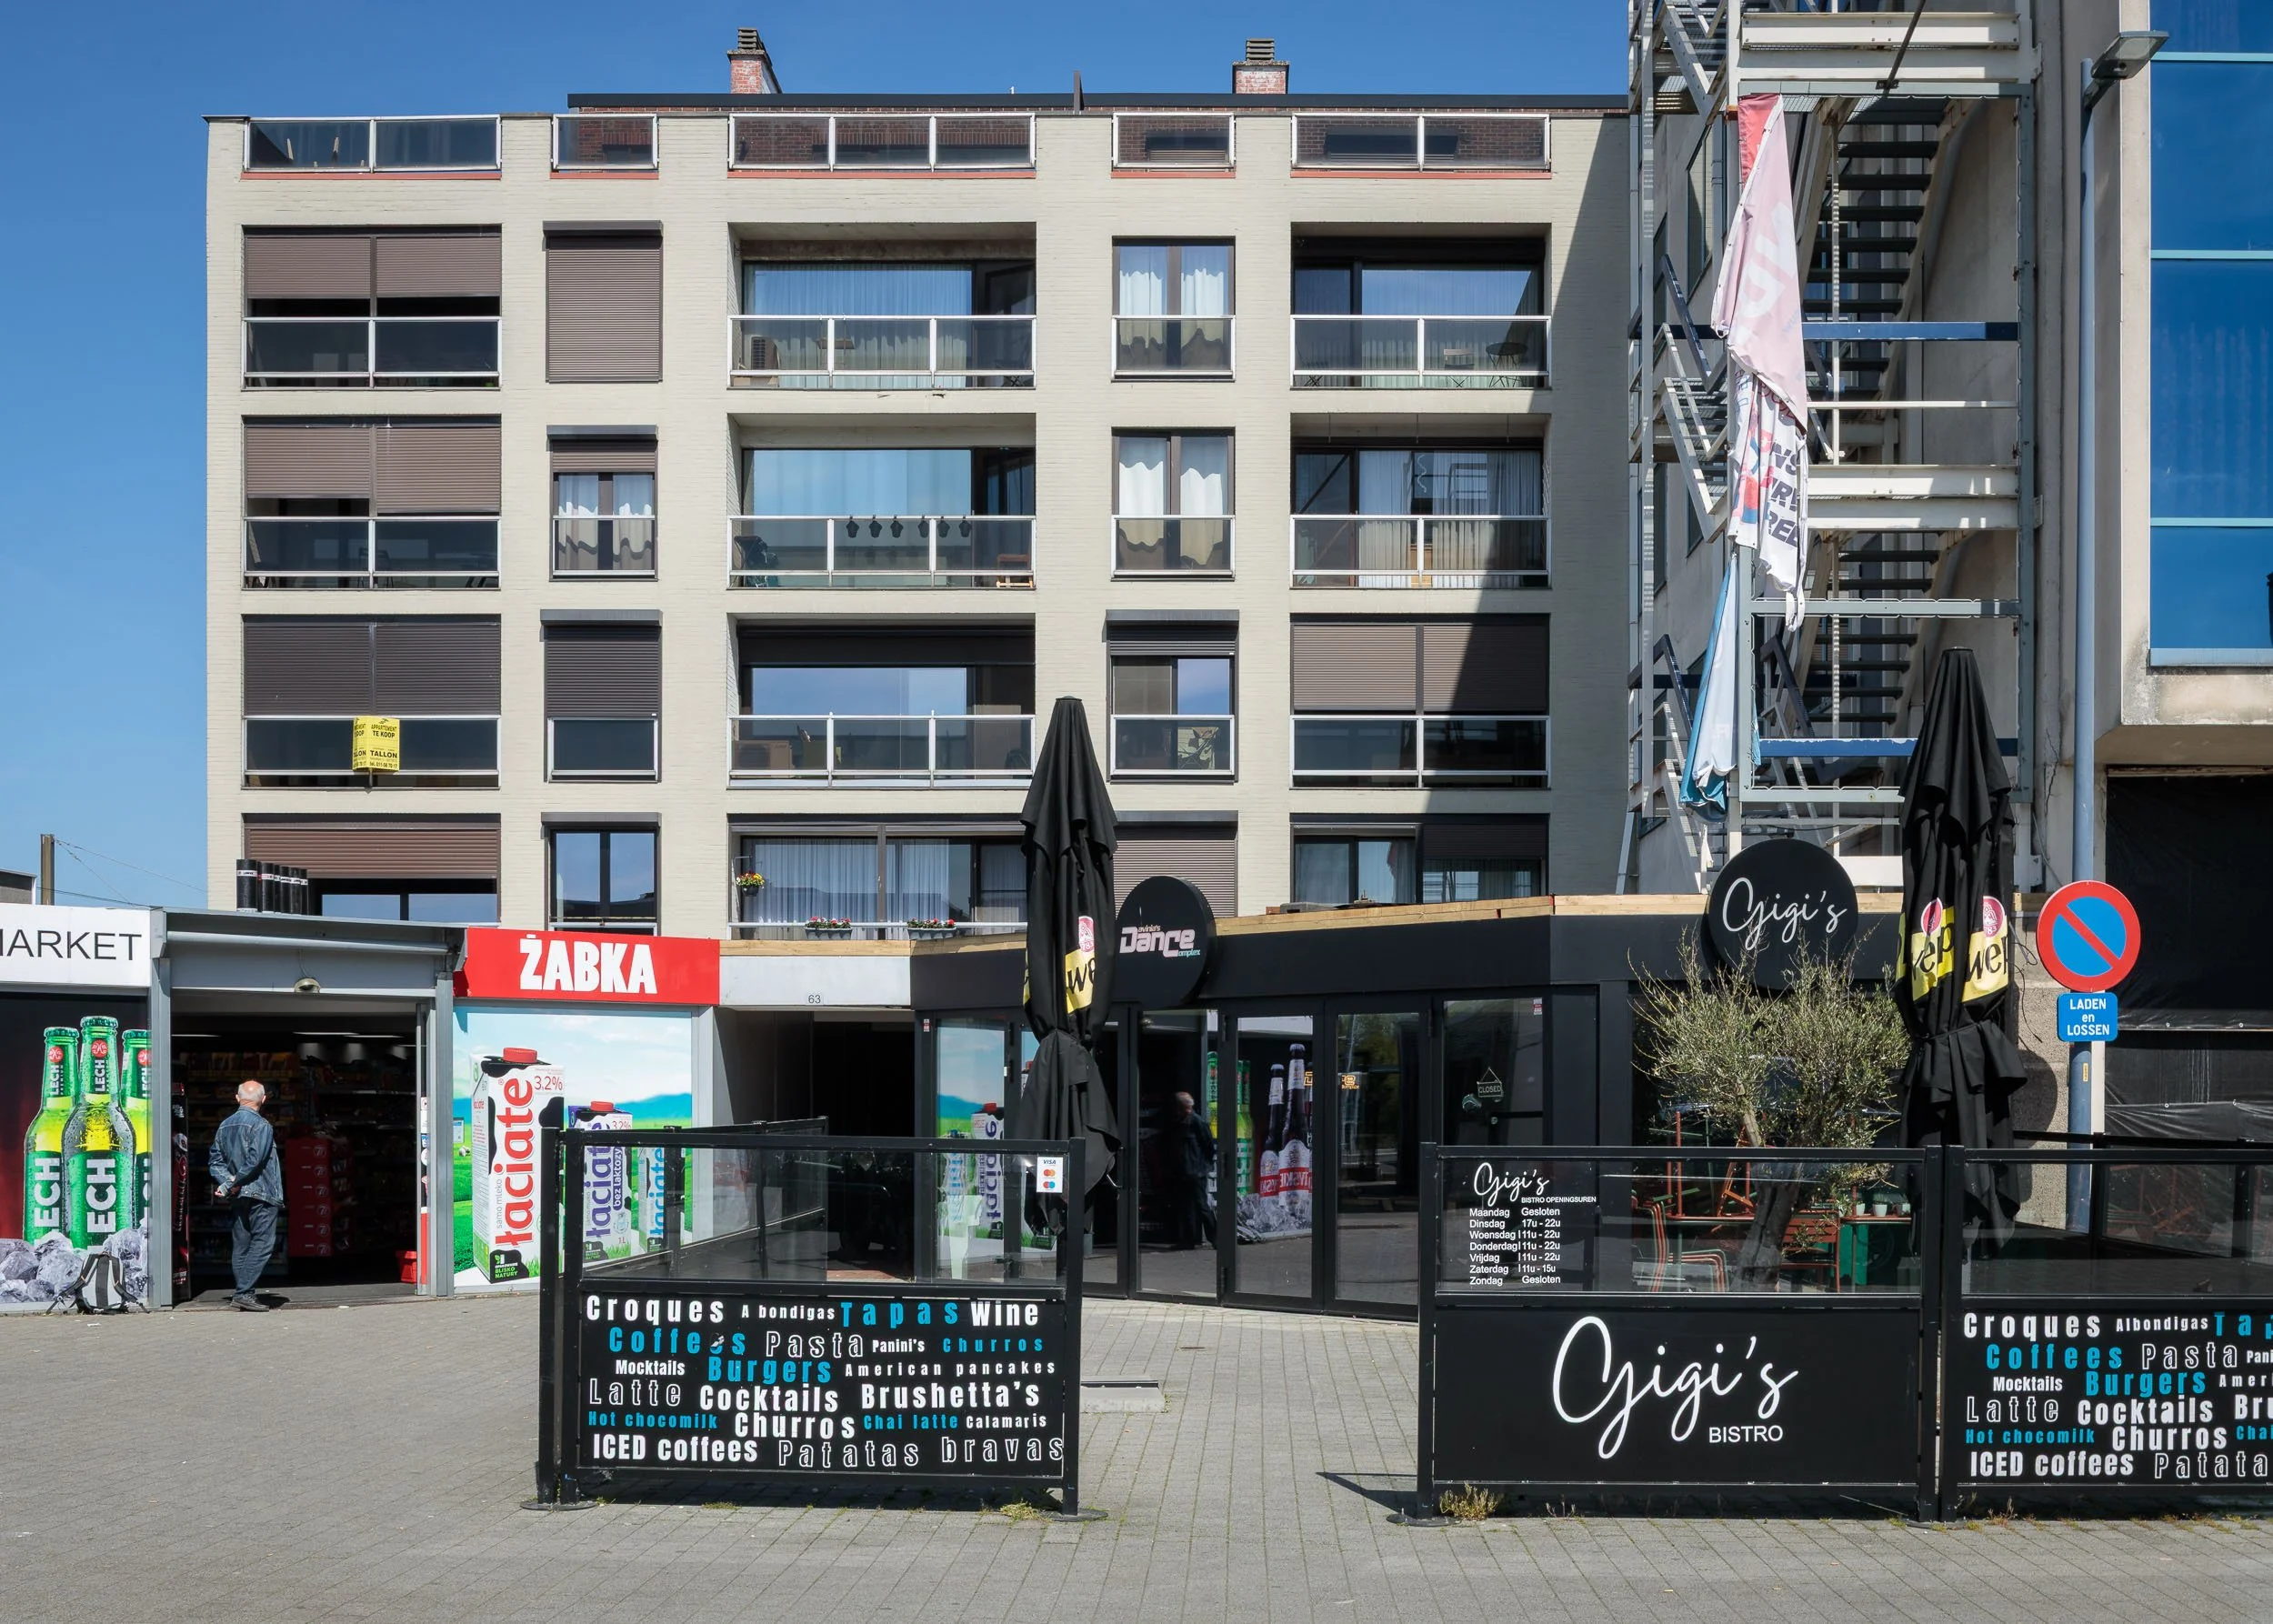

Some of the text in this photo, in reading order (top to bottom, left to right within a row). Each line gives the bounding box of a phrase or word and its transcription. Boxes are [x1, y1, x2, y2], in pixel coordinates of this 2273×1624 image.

[370, 750, 397, 758] TALLON
[1722, 877, 1847, 951] Gigi's
[0, 928, 142, 961] ARKET
[519, 934, 657, 994] ŻABKA
[808, 994, 821, 1004] 63
[2069, 998, 2107, 1010] LADEN
[2067, 1024, 2109, 1036] LOSSEN
[2082, 1014, 2095, 1022] en
[95, 1059, 105, 1091] LECH
[614, 1148, 623, 1208] bez laktozy
[1474, 1162, 1549, 1207] Gigi's
[1469, 1208, 1560, 1218] Maandag Gesloten
[1469, 1219, 1505, 1229] Dinsdag
[1522, 1218, 1537, 1228] 17u
[1545, 1218, 1561, 1228] 22u
[1469, 1230, 1516, 1240] Woensdag
[1522, 1230, 1537, 1238] 11u
[1545, 1230, 1560, 1238] 22u
[1469, 1242, 1517, 1251] Donderdag
[1522, 1241, 1537, 1250] 11u
[1545, 1241, 1560, 1249] 22u
[1469, 1253, 1500, 1263] Vrijdag
[1522, 1253, 1537, 1261] 11u
[1545, 1252, 1560, 1261] 22u
[1469, 1265, 1509, 1274] Zaterdag
[1522, 1264, 1536, 1273] 11u
[1542, 1264, 1556, 1272] 15u
[1469, 1276, 1561, 1286] Zondag Gesloten
[586, 1295, 724, 1326] Croques
[841, 1302, 958, 1328] Tapas
[971, 1300, 1038, 1327] Wine
[1964, 1313, 2100, 1341] Croques
[2116, 1315, 2208, 1332] Albondigas
[766, 1330, 863, 1358] Pasta
[872, 1338, 925, 1353] Panini's
[943, 1338, 1043, 1353] Churros
[1987, 1343, 2122, 1369] Coffees
[2142, 1342, 2238, 1370] Pasta
[616, 1357, 1055, 1384] Mocktails Burgers American pancakes
[589, 1378, 1039, 1412] Latte Cocktails Brushetta's
[1553, 1317, 1799, 1459] Gigi's
[1993, 1376, 2063, 1392] Mocktails
[2086, 1371, 2206, 1398] Burgers
[1967, 1396, 2059, 1423] Latte
[2078, 1395, 2213, 1426] Cocktails
[588, 1410, 1046, 1439] Hot chocomilk Churros Chai latte Calamaris
[1709, 1425, 1784, 1443] BISTRO
[1966, 1429, 1994, 1444] Hot
[2003, 1429, 2095, 1444] chocomilk
[2112, 1425, 2228, 1451] Churros
[593, 1434, 1064, 1469] ICED coffees Patatas bravas
[1970, 1450, 2268, 1479] ICED coffees Patata
